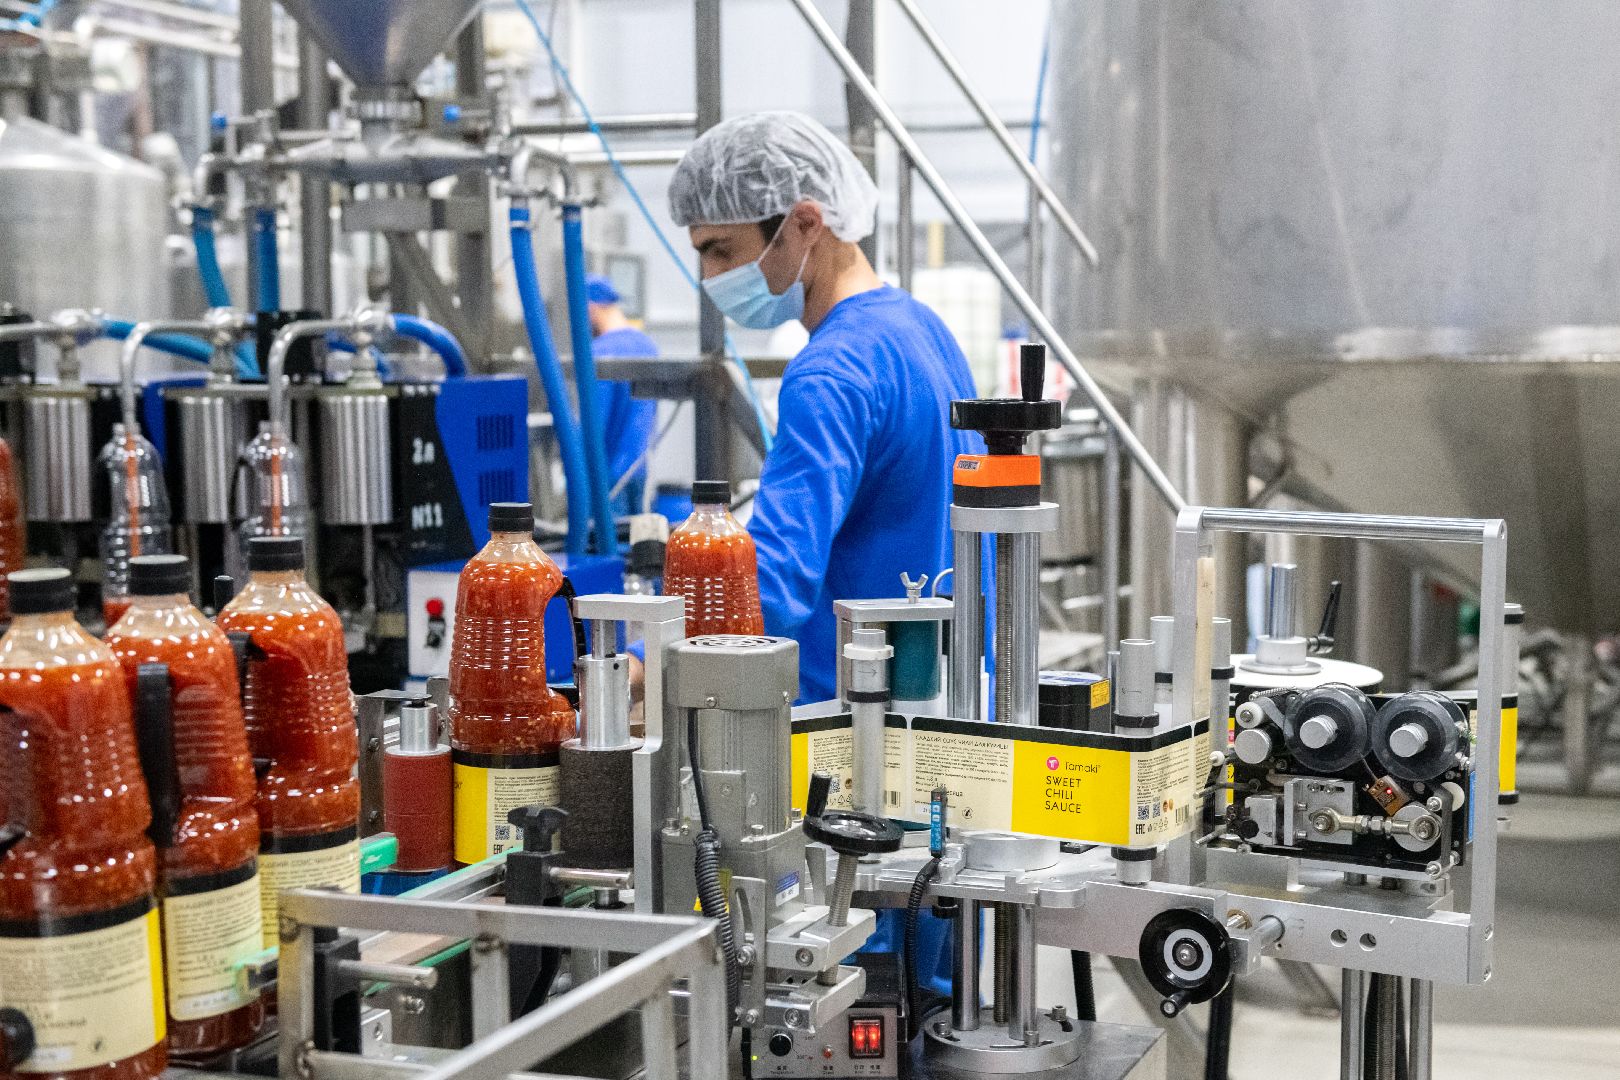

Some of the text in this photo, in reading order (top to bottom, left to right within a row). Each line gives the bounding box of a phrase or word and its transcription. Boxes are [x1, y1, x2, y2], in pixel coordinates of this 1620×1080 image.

[1046, 775, 1082, 788] SWEET
[1045, 787, 1073, 800] CHILI
[1045, 800, 1082, 814] SAUCE
